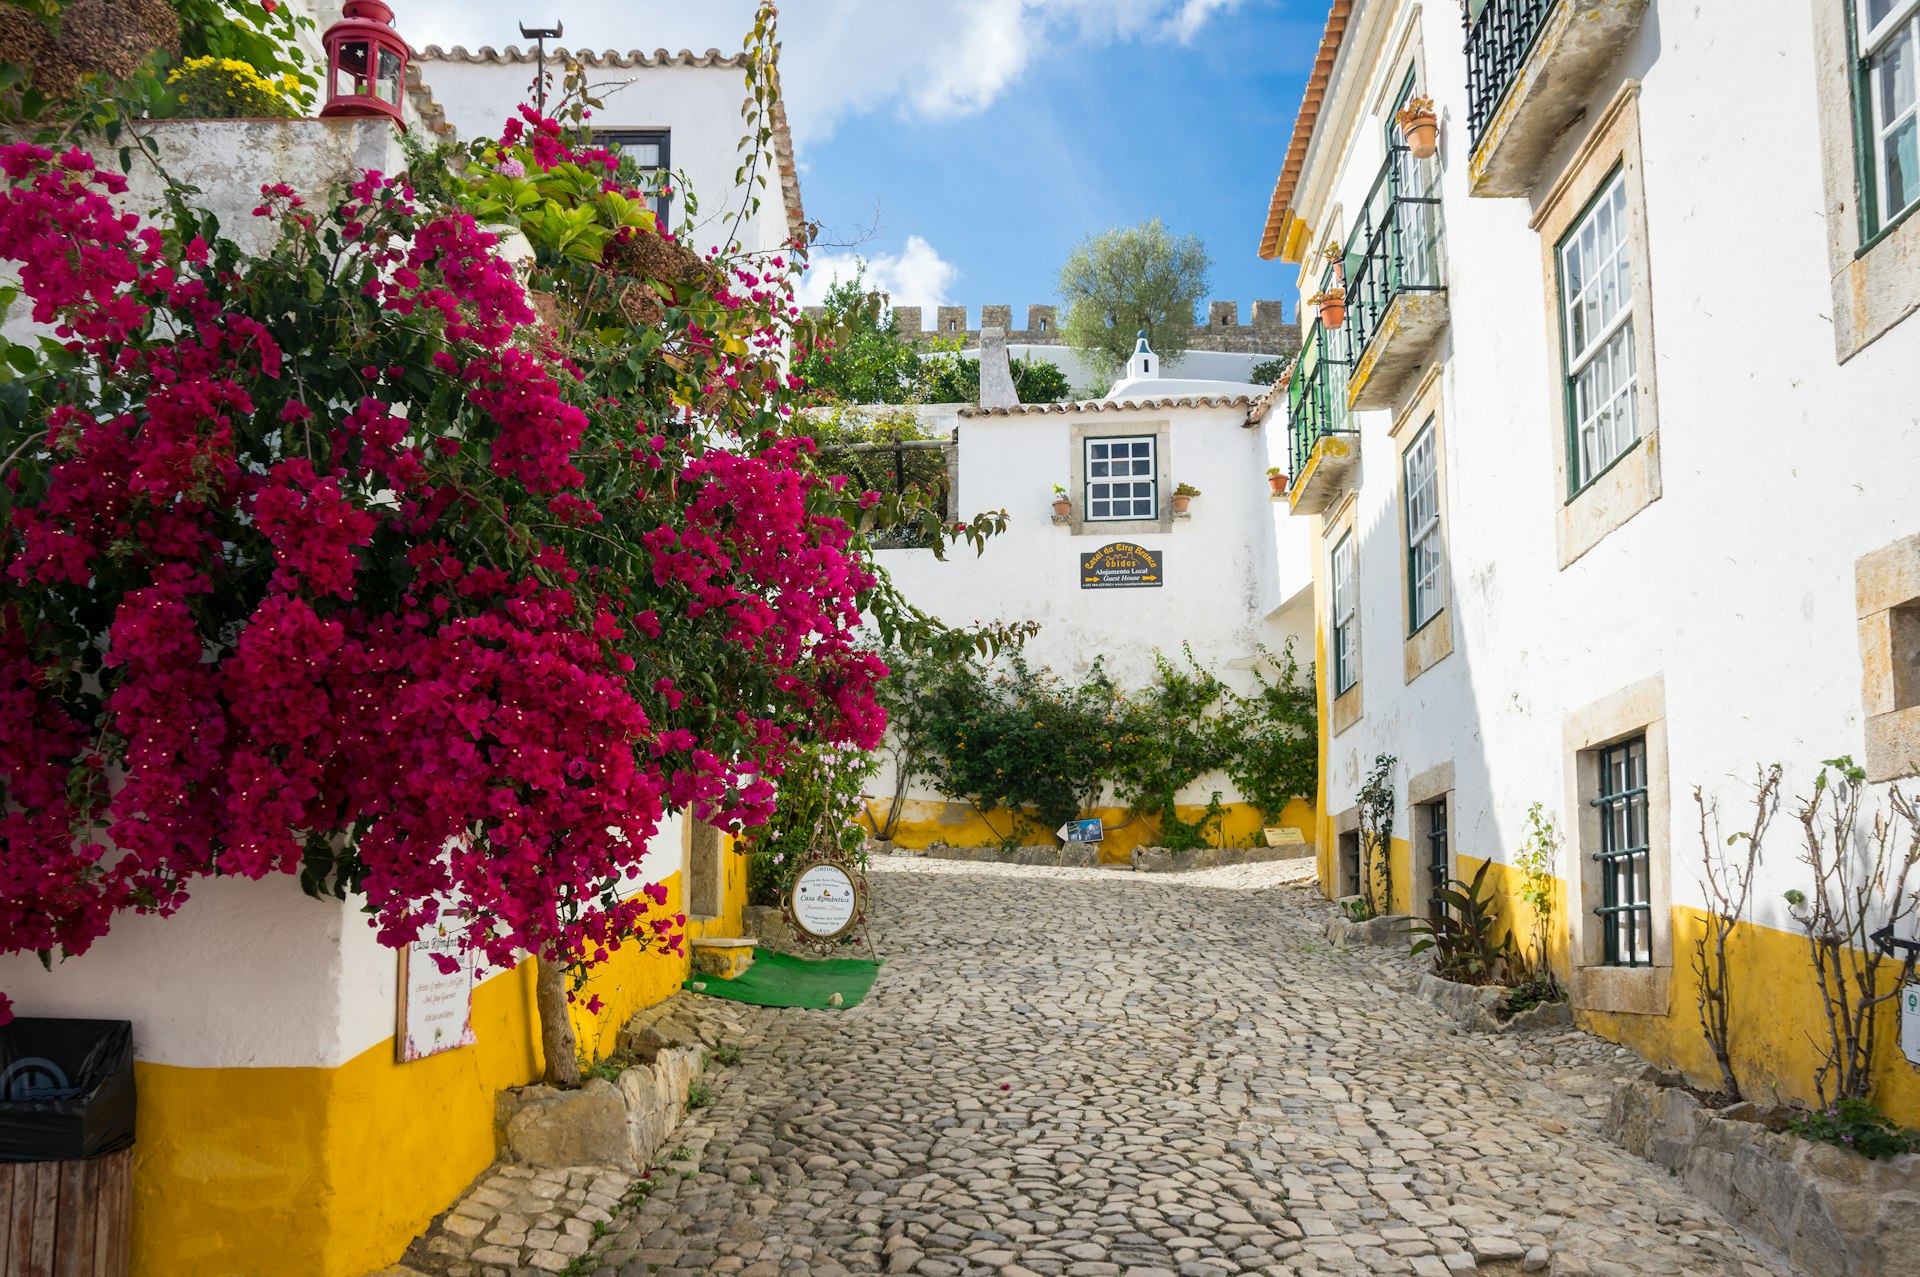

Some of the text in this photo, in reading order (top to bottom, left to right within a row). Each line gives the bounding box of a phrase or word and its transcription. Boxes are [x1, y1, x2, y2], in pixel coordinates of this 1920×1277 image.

[1085, 550, 1104, 570] Casal
[1103, 546, 1114, 554] da
[1134, 546, 1157, 568] Branca
[1121, 574, 1141, 582] House
[412, 940, 429, 952] Casa
